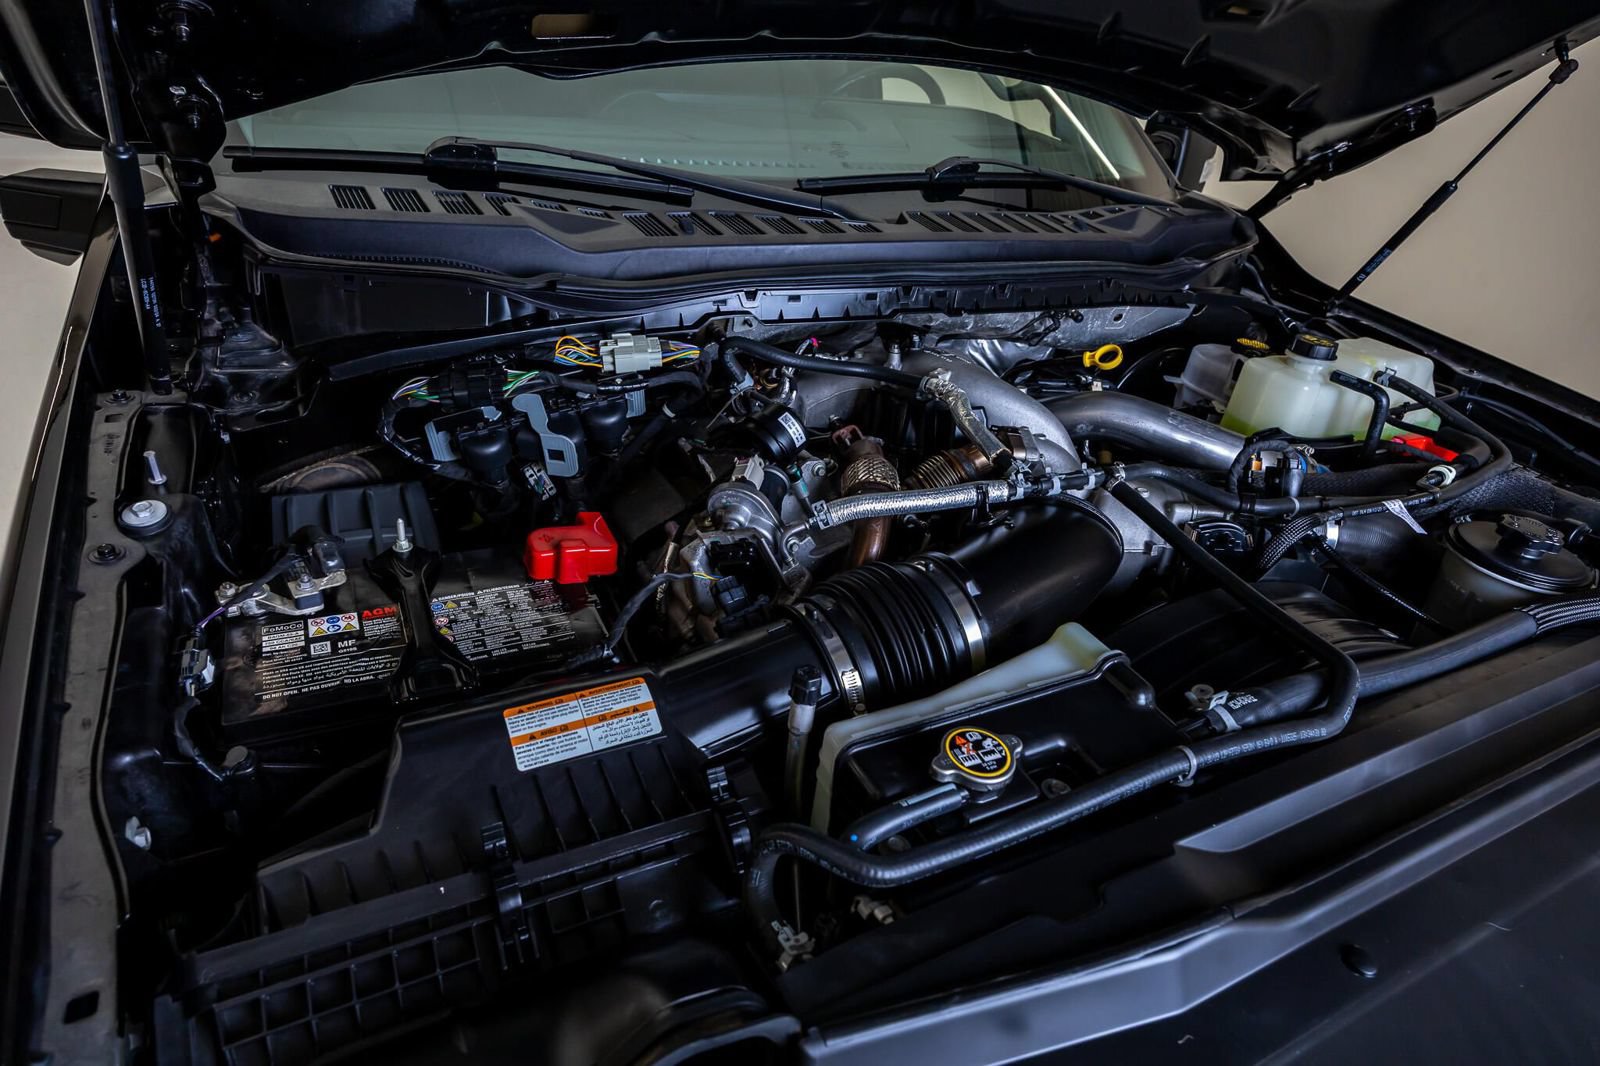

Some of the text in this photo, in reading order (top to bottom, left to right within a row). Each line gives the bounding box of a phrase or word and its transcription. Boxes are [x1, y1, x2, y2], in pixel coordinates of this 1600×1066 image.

[362, 606, 397, 618] AGM
[263, 623, 302, 633] FoMoCo
[338, 639, 356, 648] MF
